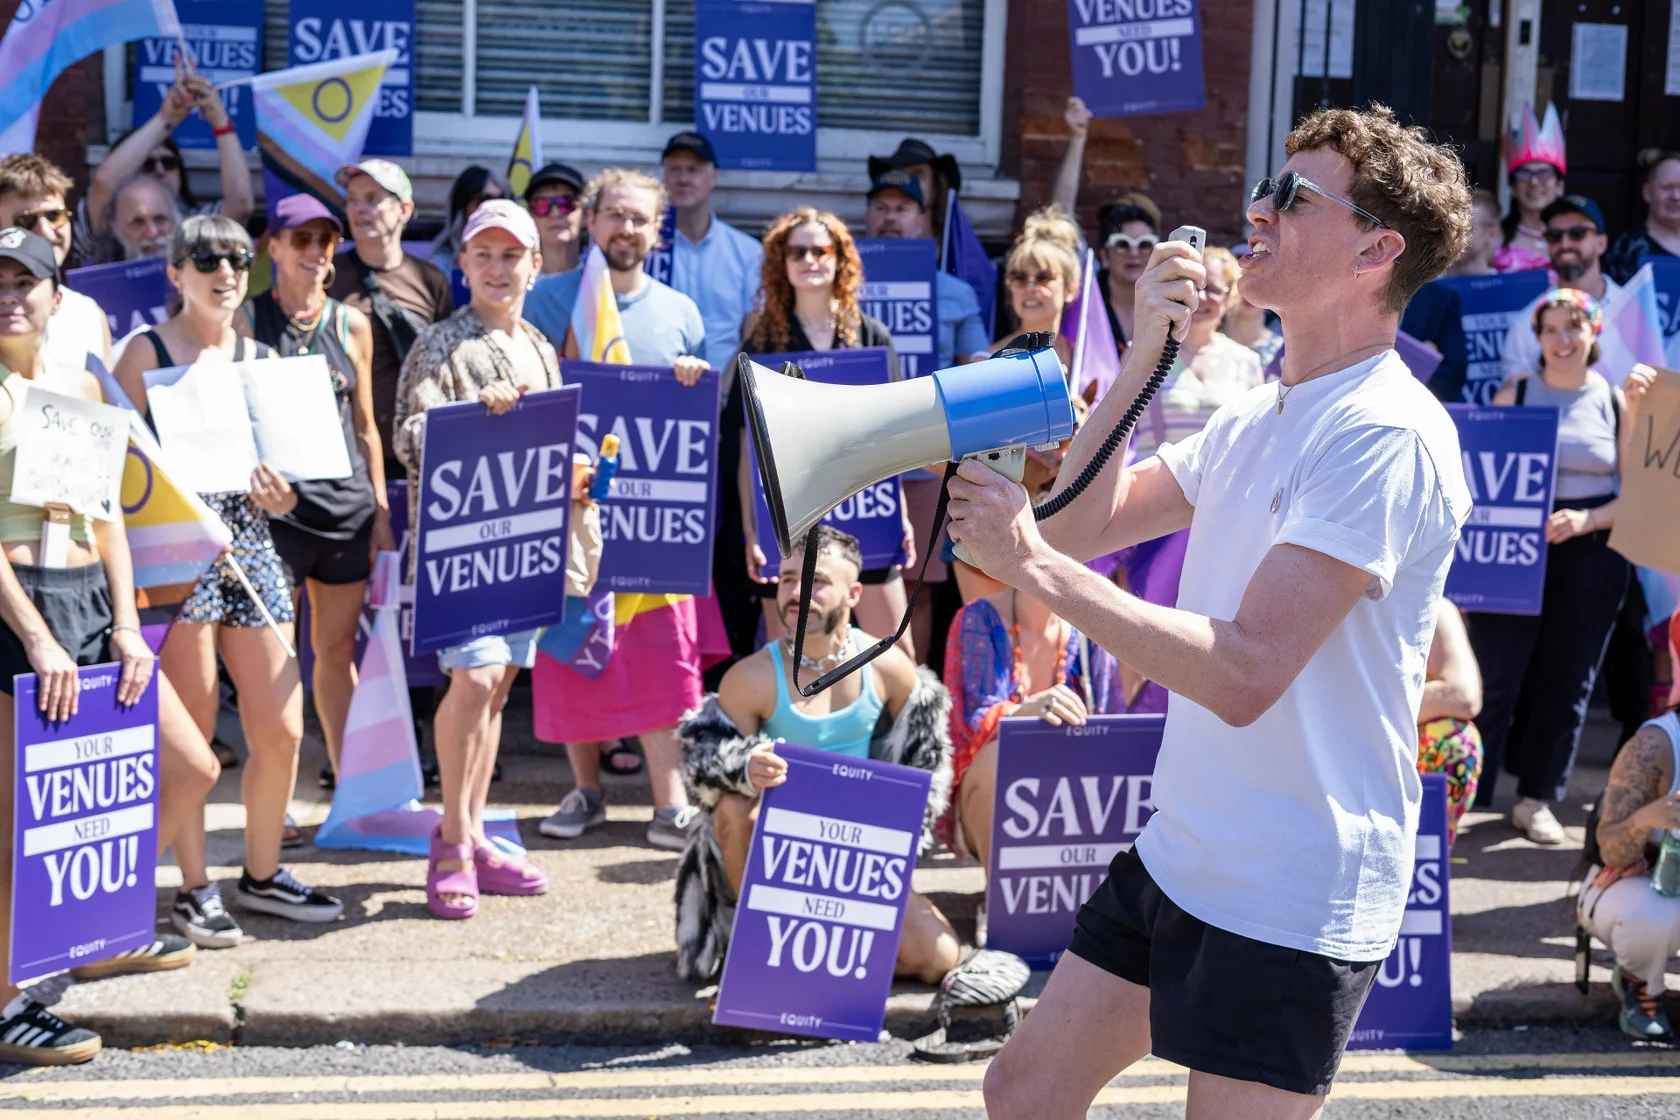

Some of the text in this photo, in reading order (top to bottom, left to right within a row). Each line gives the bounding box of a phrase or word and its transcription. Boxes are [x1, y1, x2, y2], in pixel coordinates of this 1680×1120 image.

[294, 17, 411, 65] SAVE
[701, 36, 812, 82] SAVE
[1093, 38, 1182, 78] YOU!
[743, 87, 770, 100] OUR
[702, 103, 812, 135] VENUES
[864, 301, 932, 332] UES
[620, 370, 660, 382] EQUITY
[1468, 411, 1505, 421] EQUITY
[427, 443, 569, 521] SAVE
[618, 480, 652, 496] OUR
[1462, 451, 1549, 502] AVE
[480, 520, 512, 539] OUR
[599, 505, 706, 544] ENUES
[1454, 531, 1539, 566] NUES
[425, 536, 561, 596] VENUES
[611, 576, 652, 588] EQUITY
[471, 618, 510, 636] EQUITY
[1066, 726, 1109, 736] EQUITY
[74, 736, 113, 760] YOUR
[832, 763, 874, 781] EQUITY
[25, 753, 154, 821] VENUES
[73, 817, 110, 841] NEED
[819, 820, 862, 844] YOUR
[1061, 847, 1096, 864] OUR
[43, 835, 139, 907] YOU!
[762, 836, 907, 900] VENUES
[803, 896, 845, 919] NEED
[69, 939, 106, 959] EQUITY
[766, 916, 875, 980] YOU!
[1377, 938, 1422, 988] U!
[780, 1012, 822, 1028] EQUITY
